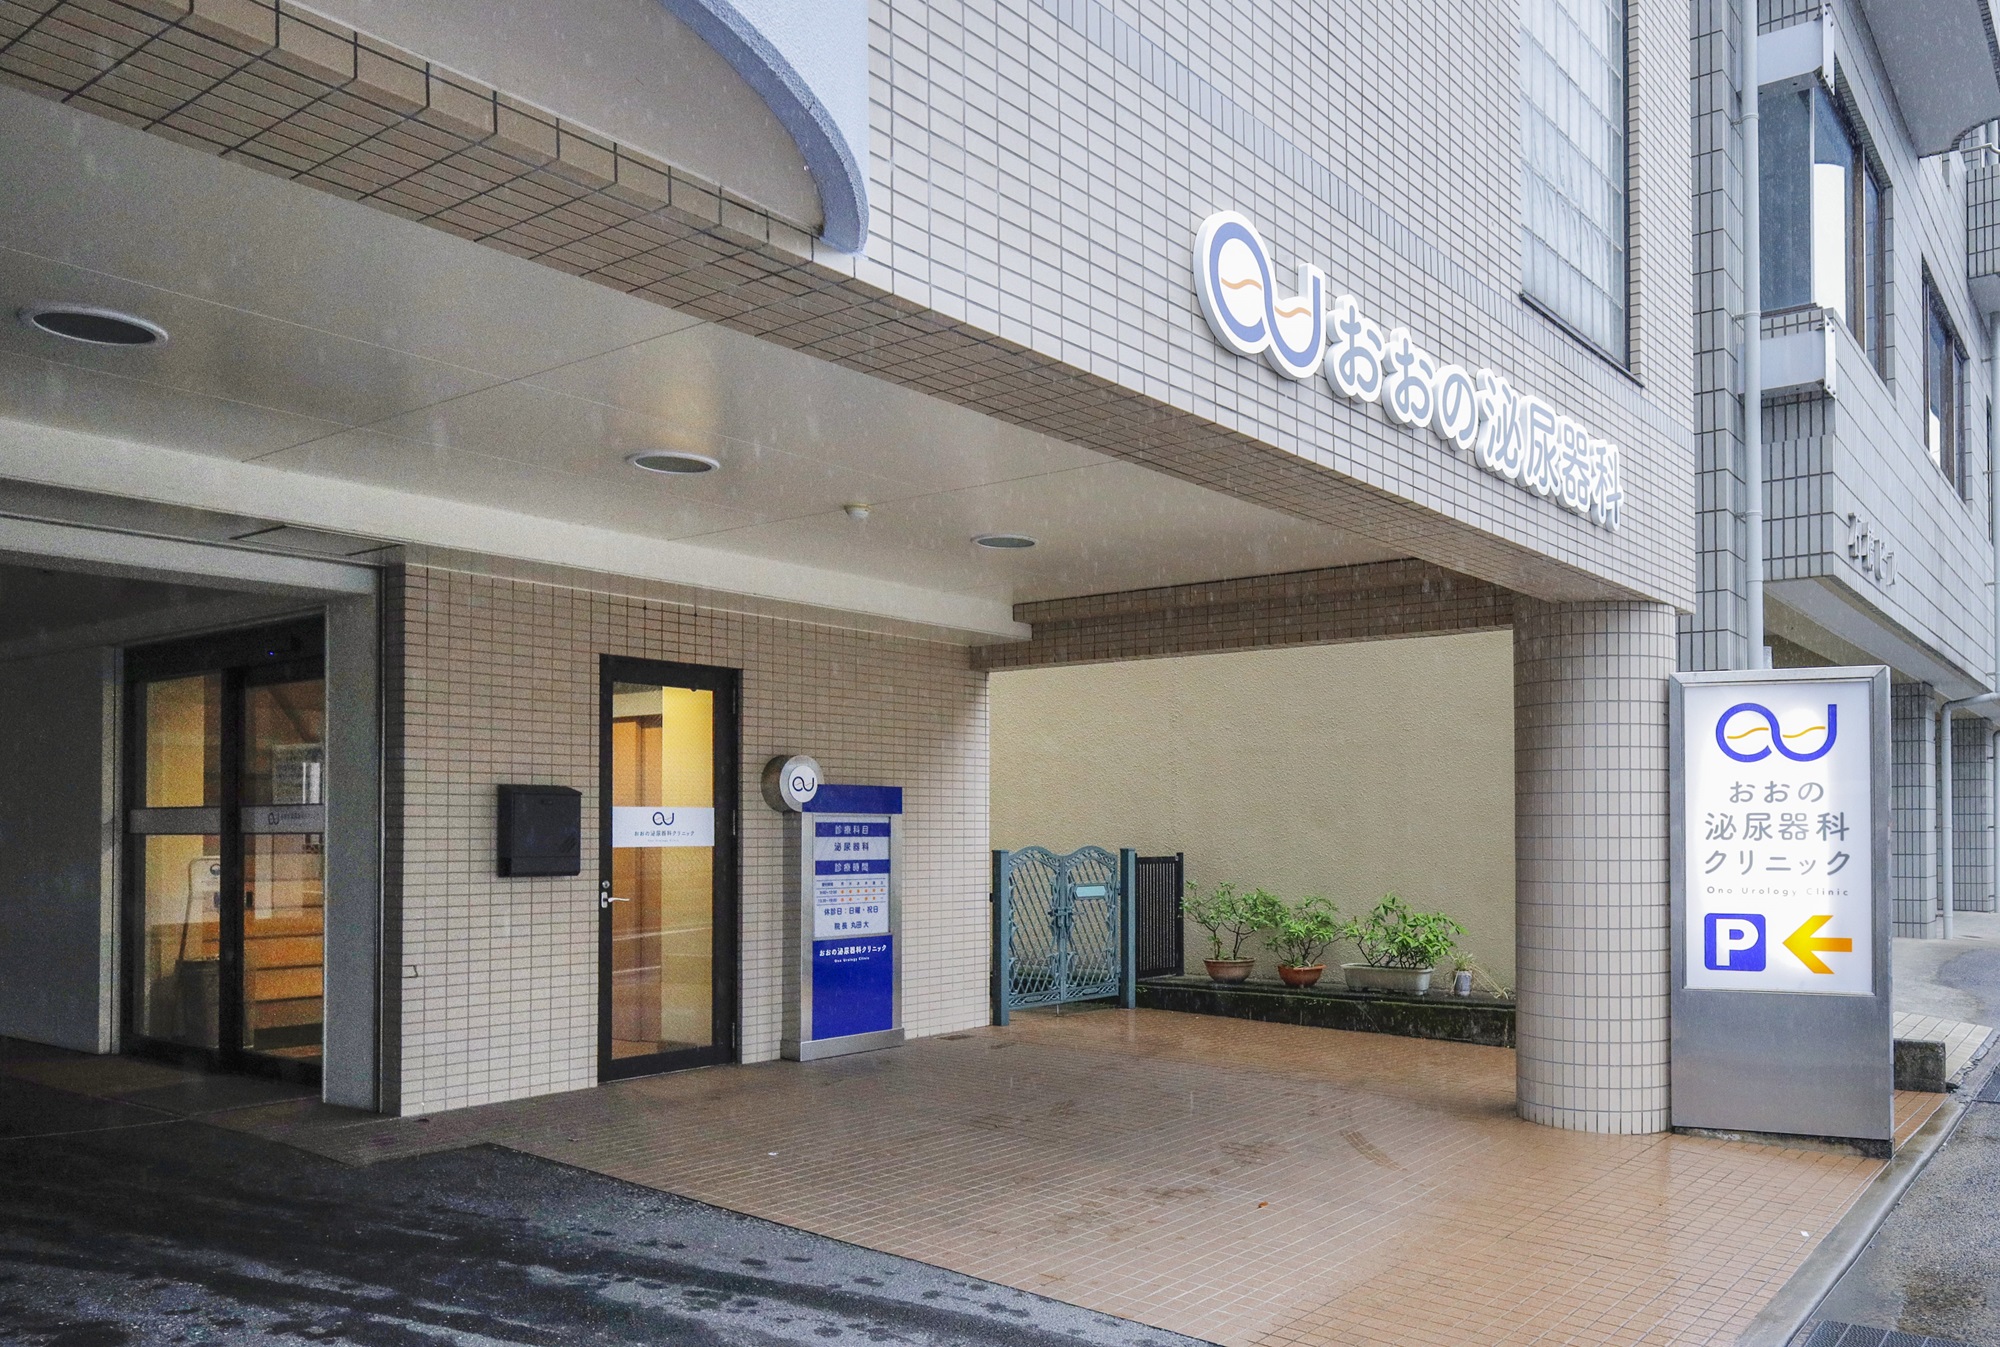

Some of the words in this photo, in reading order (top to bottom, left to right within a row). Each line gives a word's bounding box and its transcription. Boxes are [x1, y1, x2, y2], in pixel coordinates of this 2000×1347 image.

[1337, 303, 1624, 530] おおの泌尿器科
[1729, 780, 1824, 803] おおの
[834, 825, 869, 835] 診療科目
[1704, 811, 1850, 842] 泌尿器科
[834, 842, 869, 852] 泌尿器科
[834, 862, 869, 873] 診療時間
[1704, 850, 1850, 876] クリニック
[1706, 886, 1733, 895] Ono
[1741, 886, 1798, 897] Urology
[1805, 887, 1849, 897] Clinic
[819, 944, 887, 957] おおの泌尿器科クリニック
[1715, 918, 1759, 966] P
